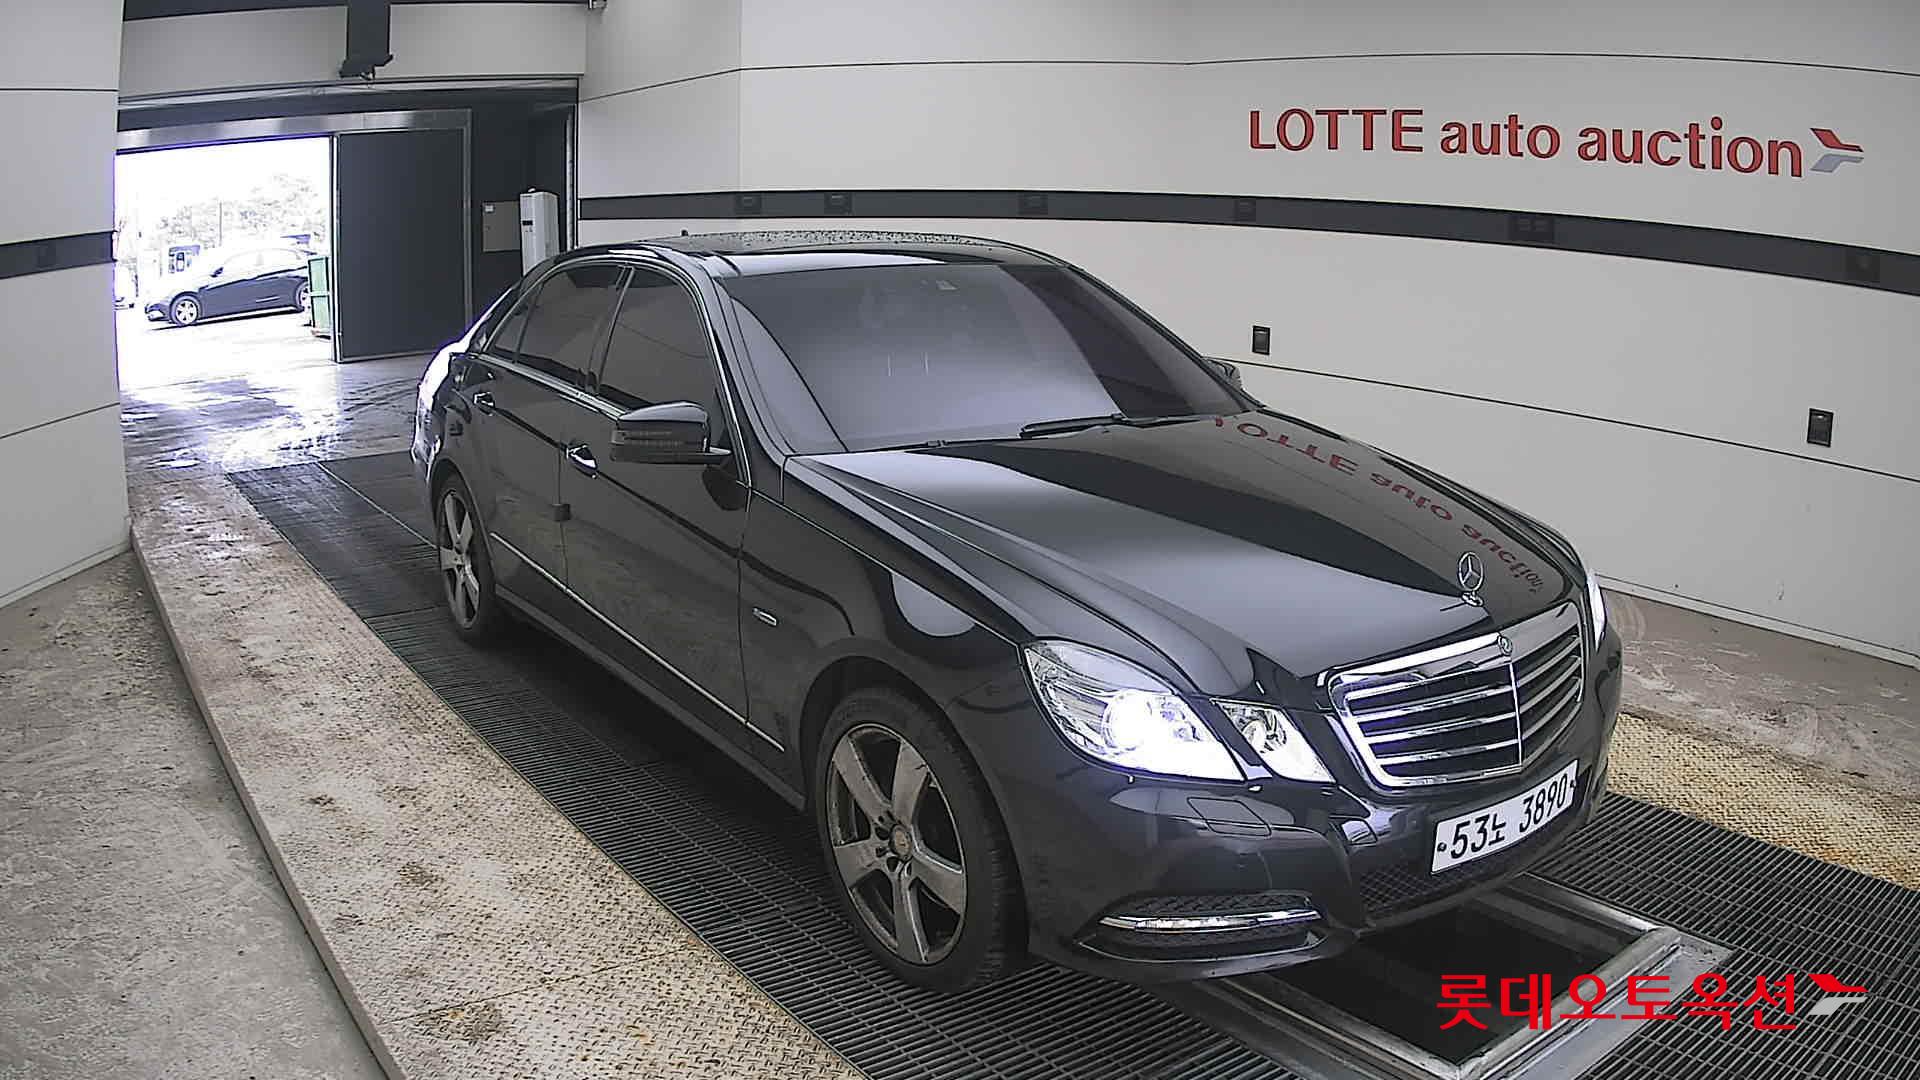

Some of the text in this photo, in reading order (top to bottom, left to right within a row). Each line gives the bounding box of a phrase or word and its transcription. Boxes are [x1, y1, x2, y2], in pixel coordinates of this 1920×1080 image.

[1250, 107, 1803, 178] LOTTE auto auction
[1450, 772, 1569, 859] 53노 3890
